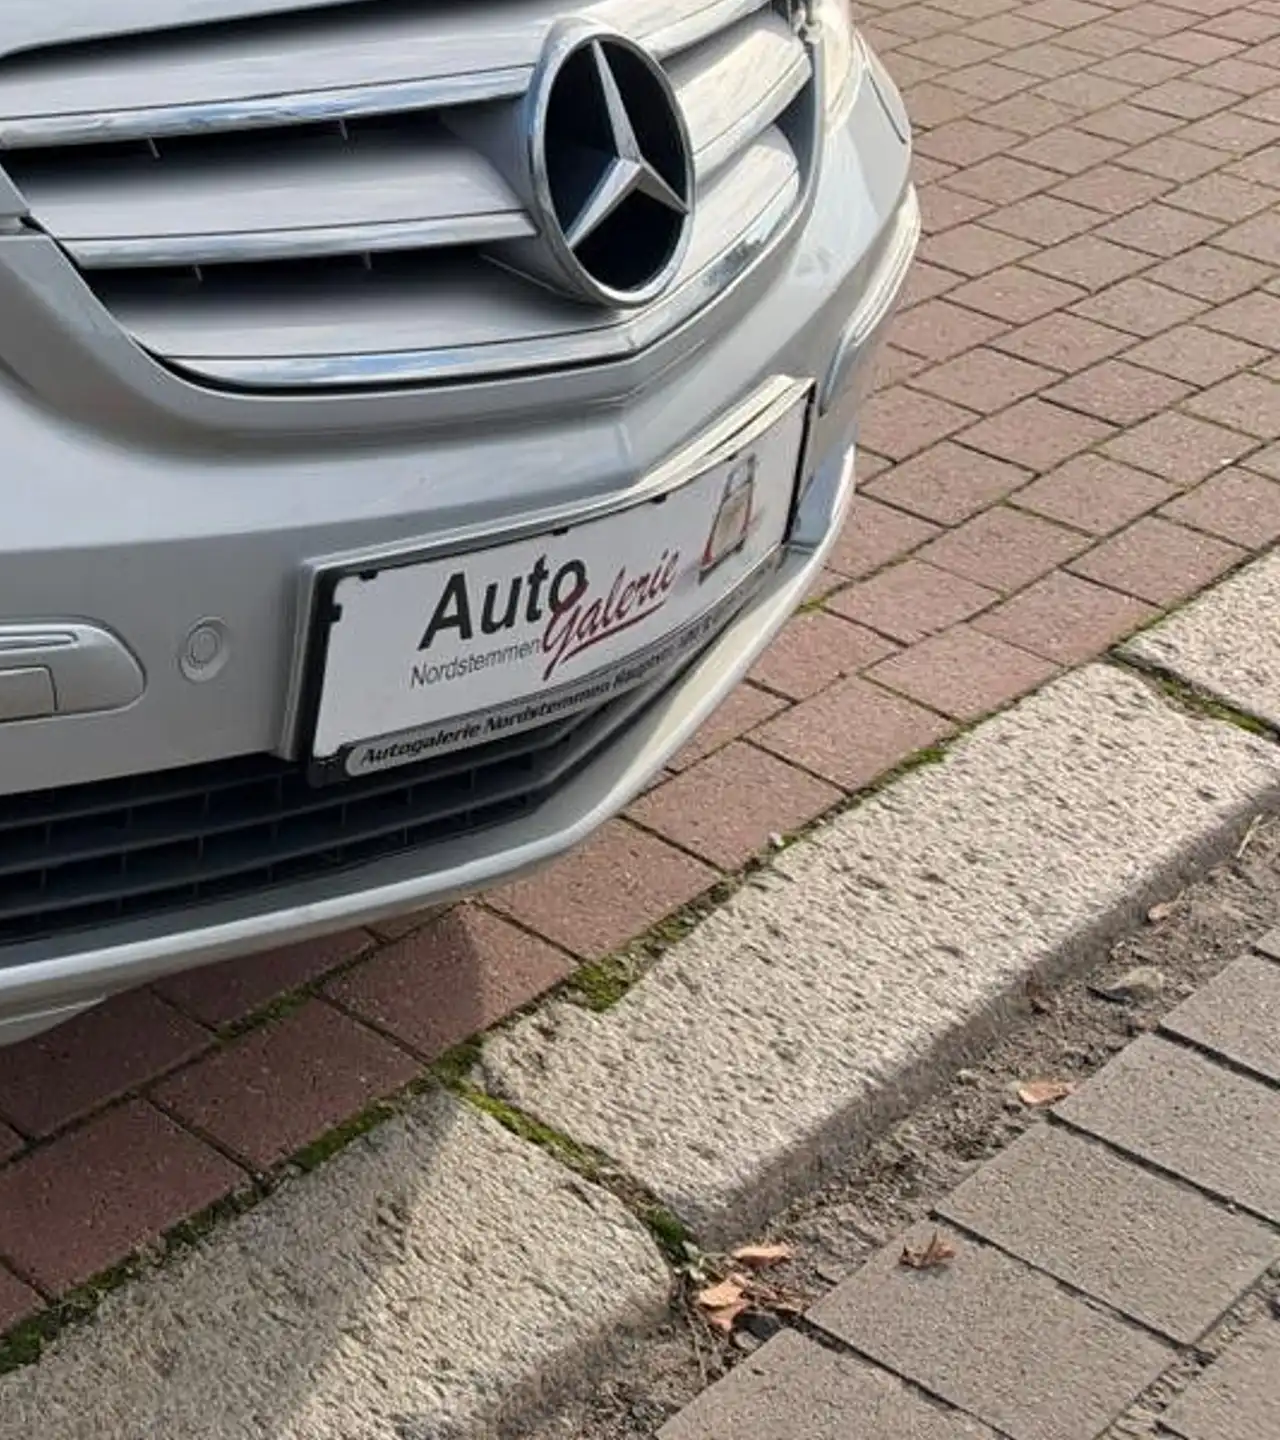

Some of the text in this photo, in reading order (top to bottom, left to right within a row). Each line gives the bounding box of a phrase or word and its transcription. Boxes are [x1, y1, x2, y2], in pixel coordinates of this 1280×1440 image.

[416, 554, 590, 652] Auto
[409, 638, 542, 689] Nordstemmen
[359, 722, 482, 766] Autogalerie
